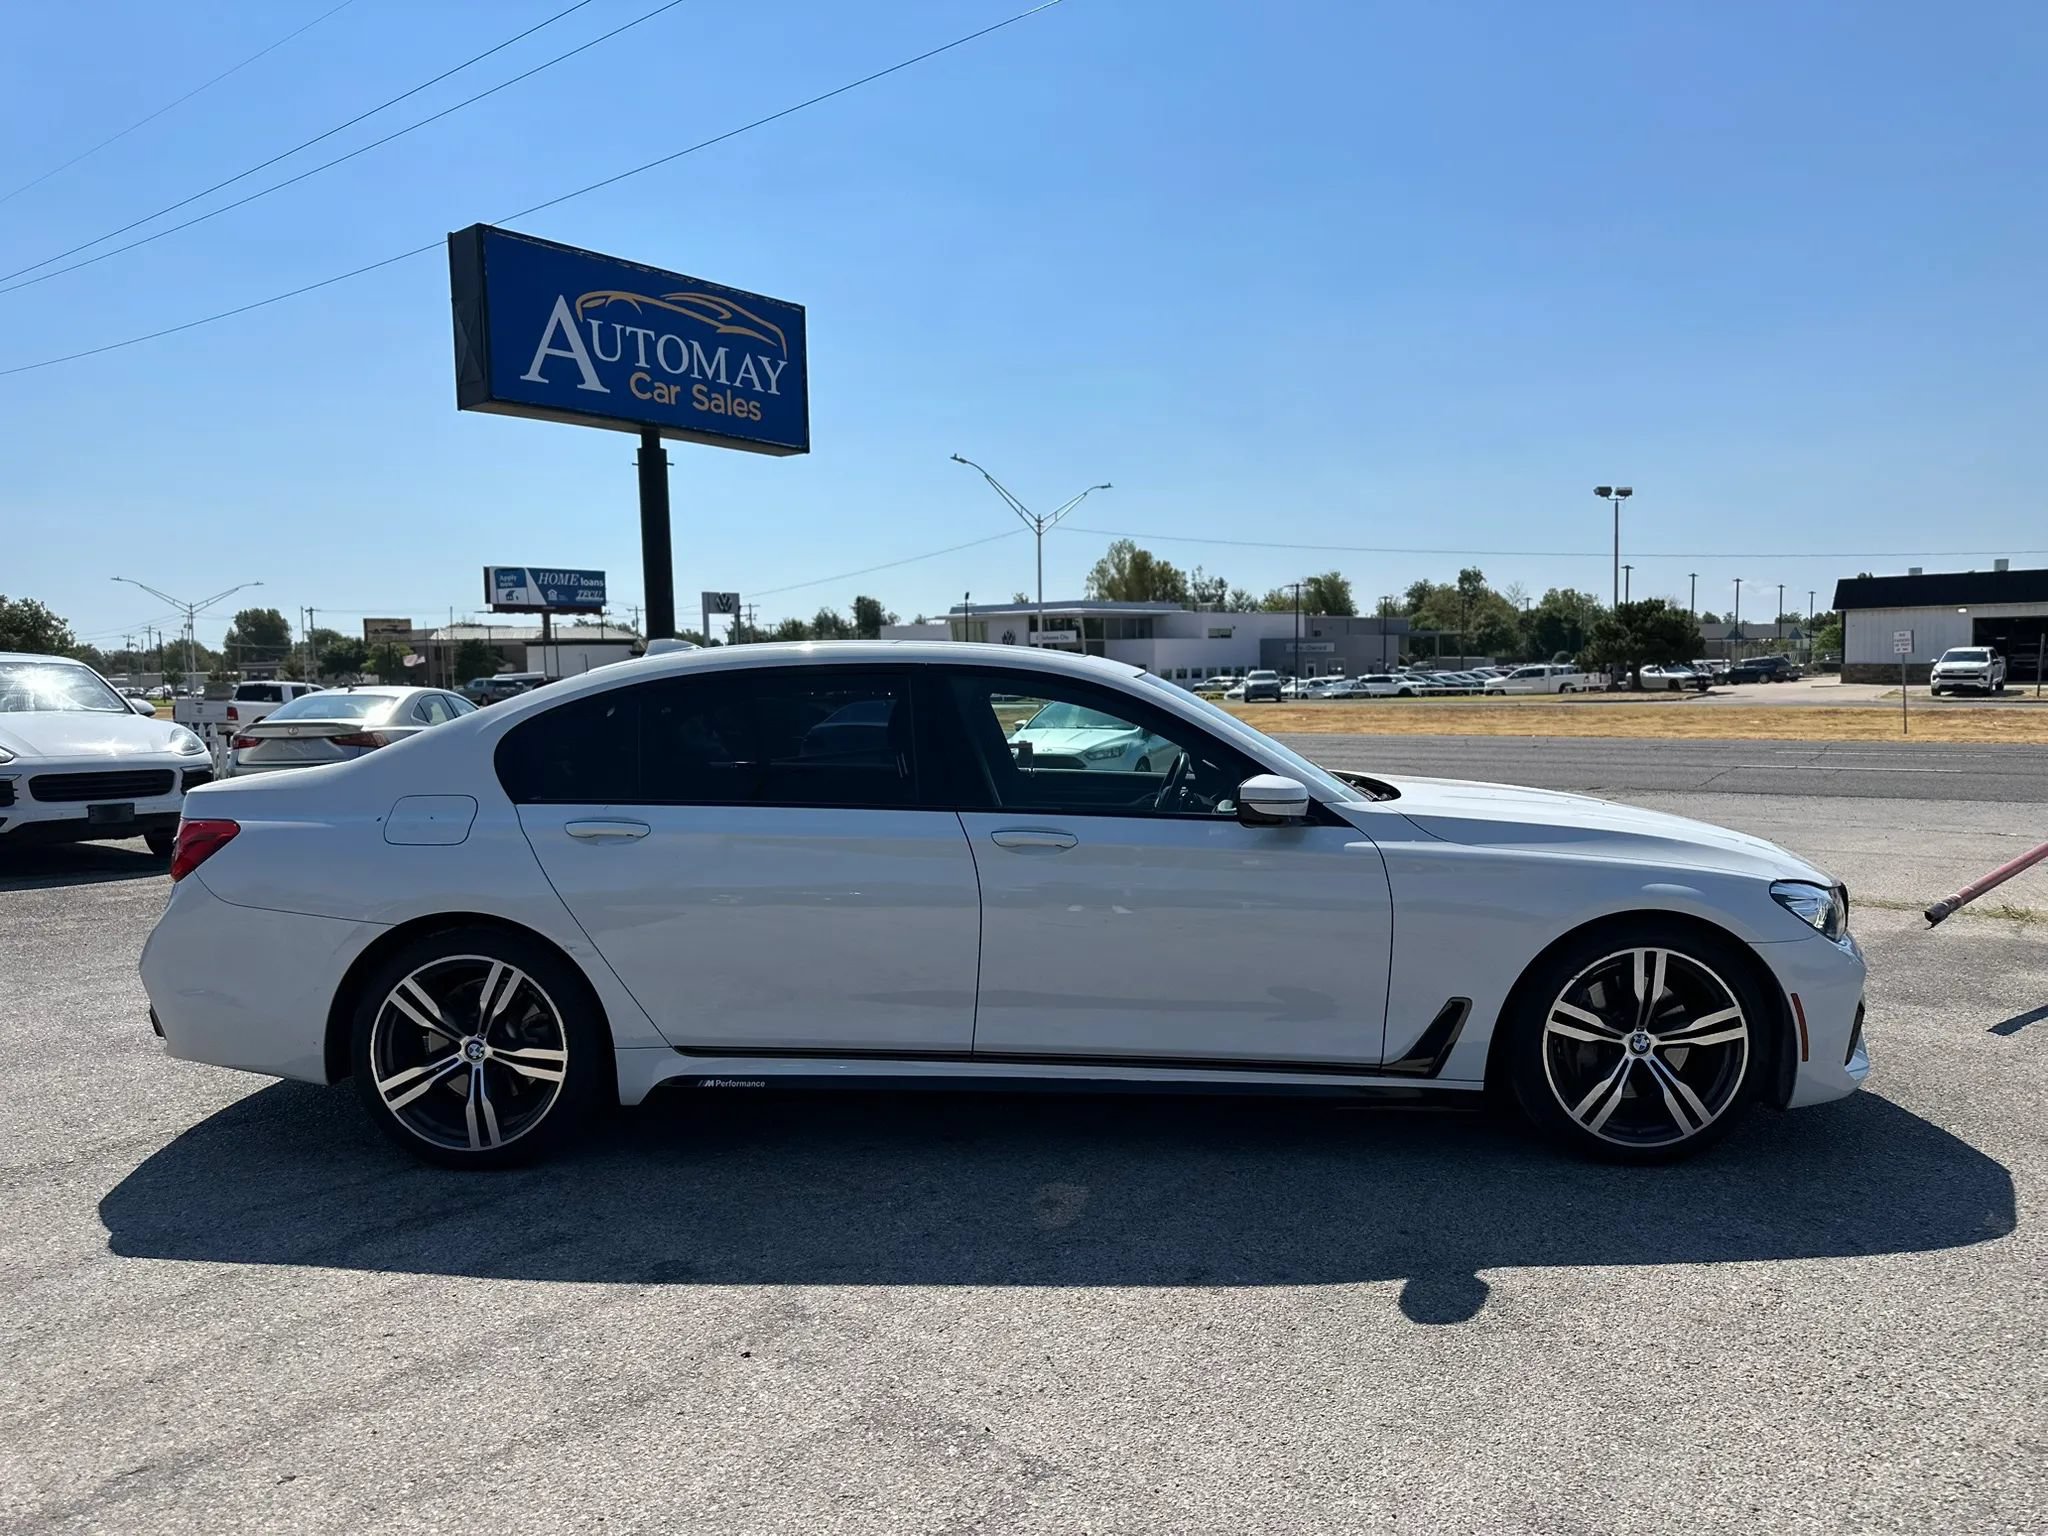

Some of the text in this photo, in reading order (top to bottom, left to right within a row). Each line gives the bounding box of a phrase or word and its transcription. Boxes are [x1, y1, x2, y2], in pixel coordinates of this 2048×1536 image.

[520, 295, 788, 395] AUTOMAY
[629, 371, 762, 422] Car Sales
[538, 571, 604, 587] HOME loans
[715, 1079, 766, 1088] Performance
